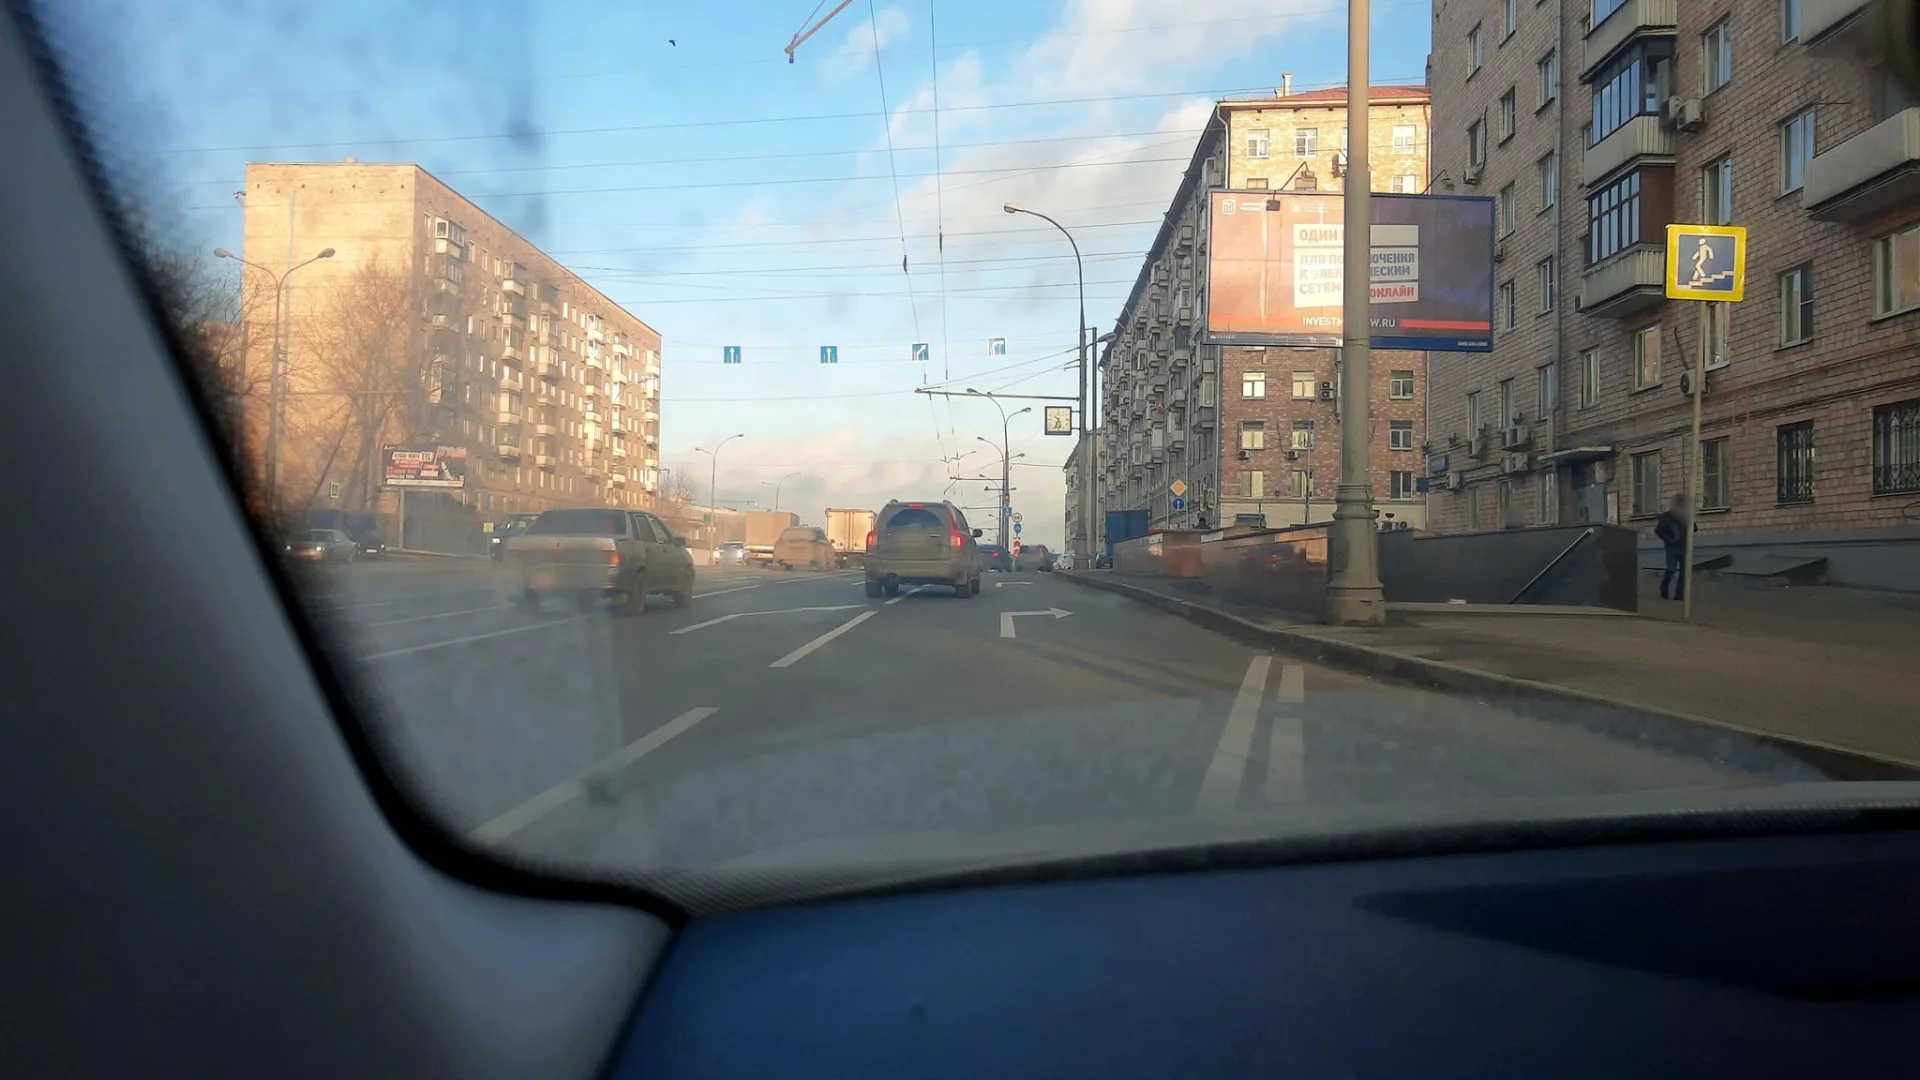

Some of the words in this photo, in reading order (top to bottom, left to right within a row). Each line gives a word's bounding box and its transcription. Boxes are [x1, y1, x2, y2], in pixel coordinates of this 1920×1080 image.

[1299, 229, 1338, 243] ОДИН
[1299, 282, 1341, 294] СЕТЯМ
[1369, 285, 1415, 298] ОНЛАЙН
